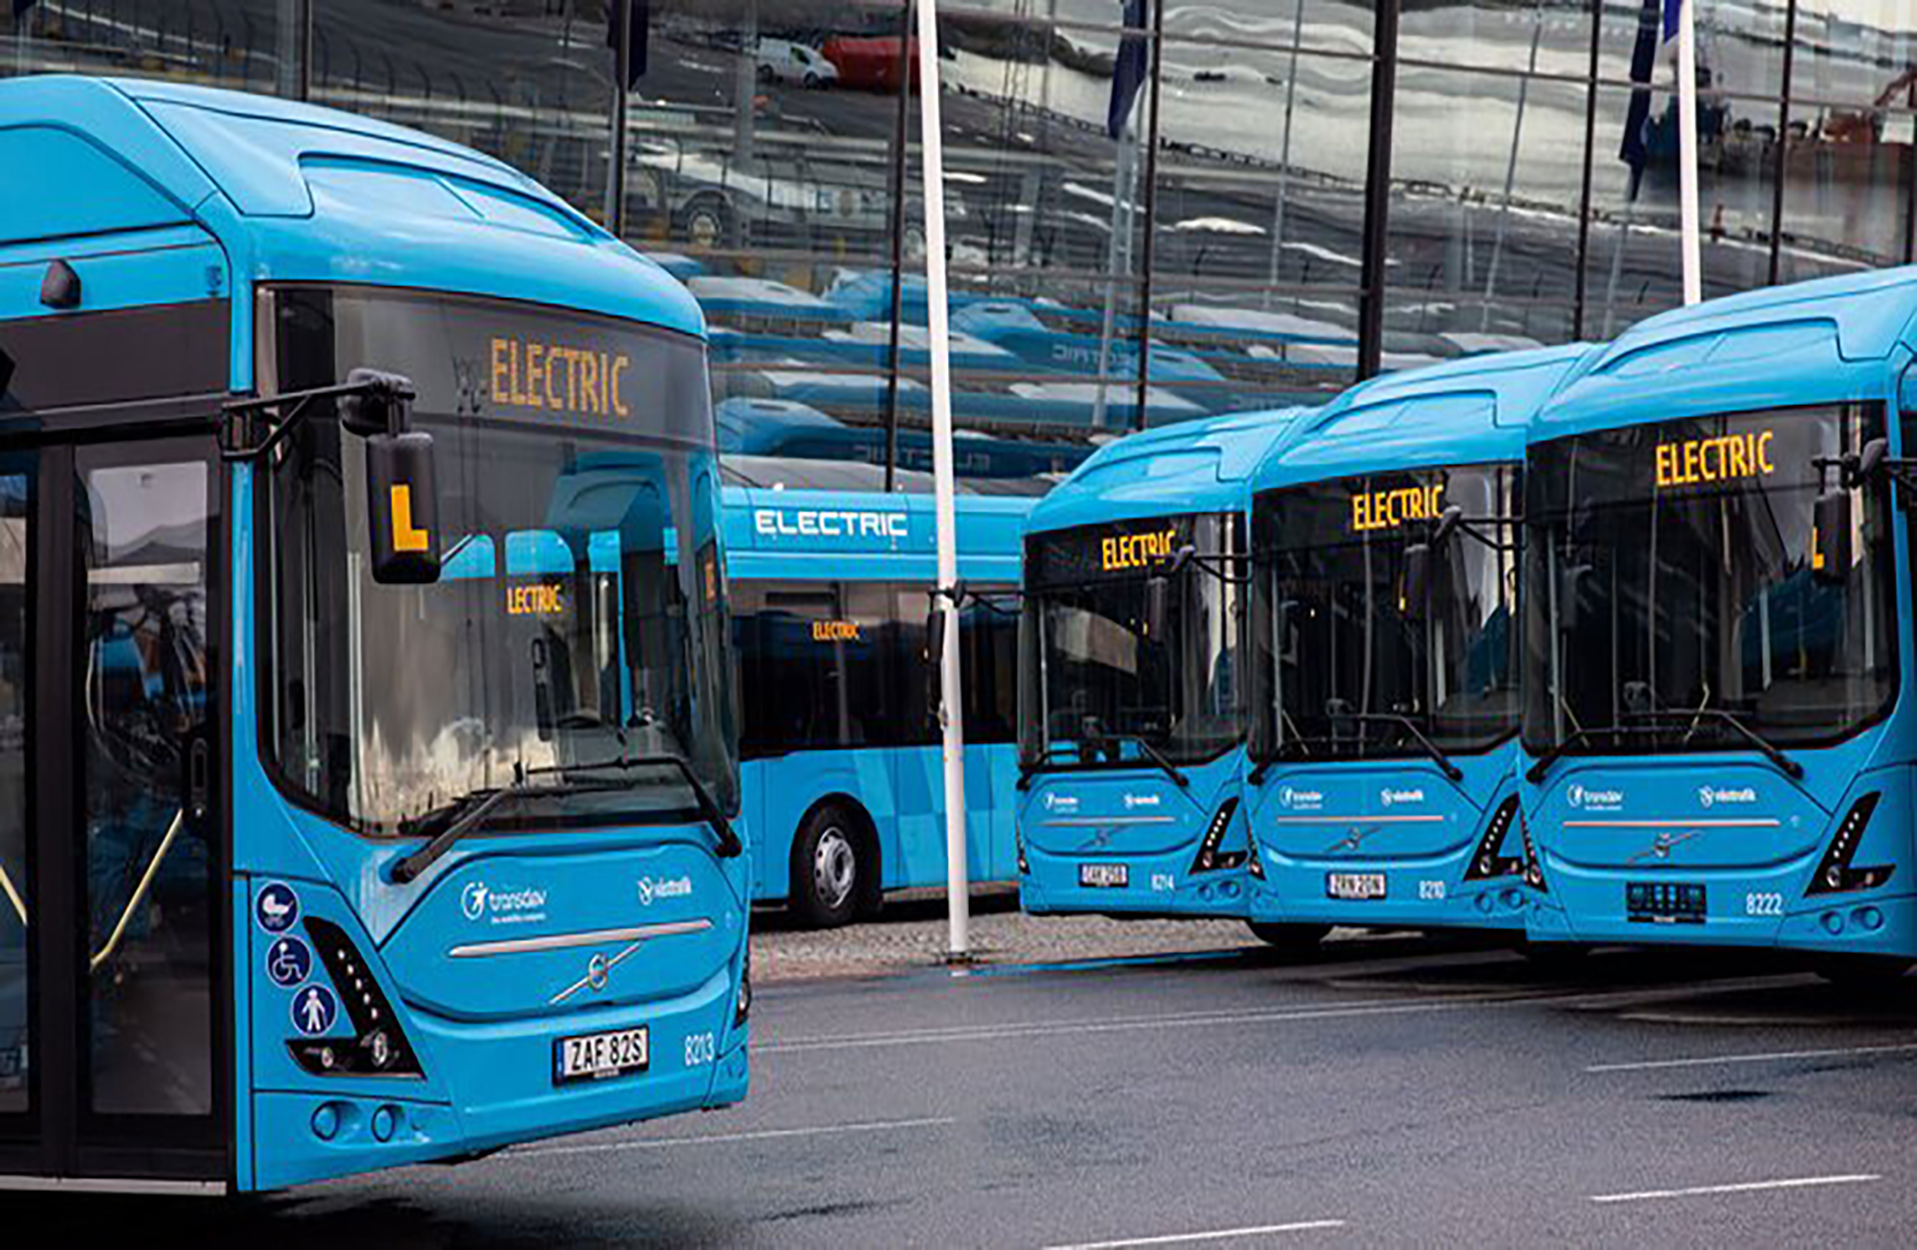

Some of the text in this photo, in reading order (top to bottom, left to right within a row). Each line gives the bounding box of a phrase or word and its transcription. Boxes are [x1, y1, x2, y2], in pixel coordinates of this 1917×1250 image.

[491, 337, 630, 416] ELECTRIC
[1655, 430, 1774, 486] ELECTRIC
[391, 484, 428, 551] L
[755, 510, 908, 536] ELECTRIC
[1353, 484, 1444, 531] ELECTRIC
[1102, 529, 1176, 572] ELECTRIC
[1746, 893, 1782, 915] 8222
[571, 1032, 643, 1071] ZAF 82S
[685, 1032, 714, 1066] 8213
